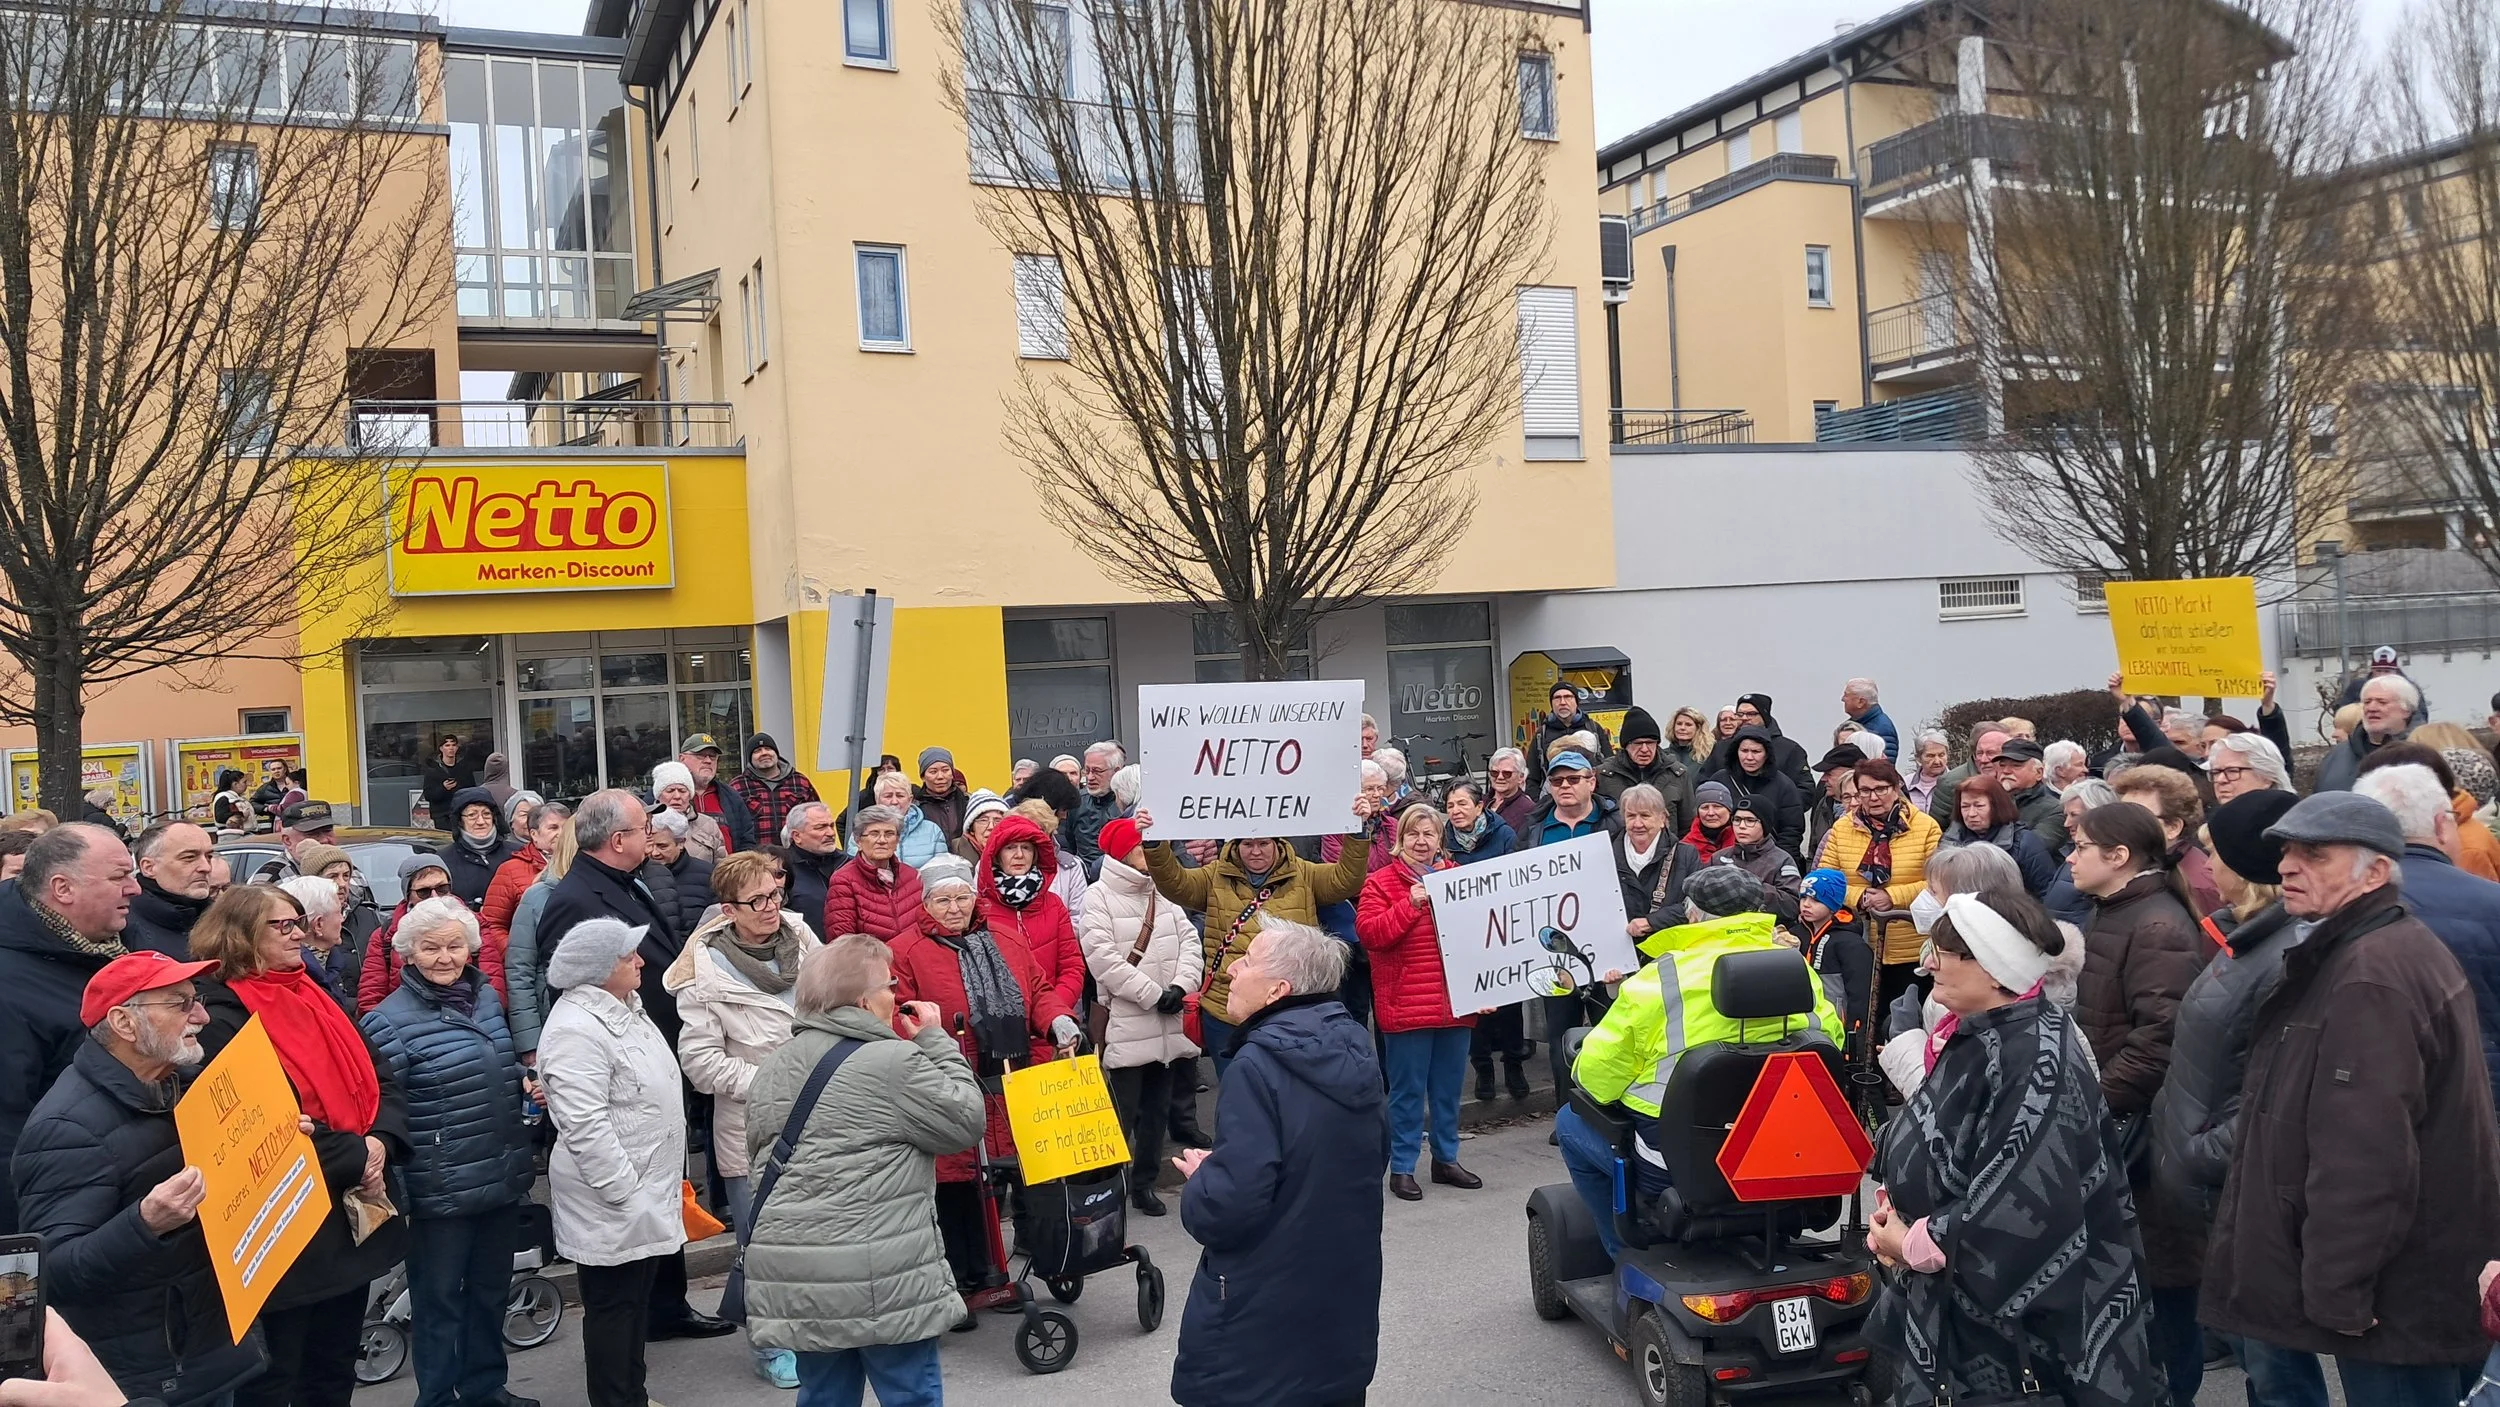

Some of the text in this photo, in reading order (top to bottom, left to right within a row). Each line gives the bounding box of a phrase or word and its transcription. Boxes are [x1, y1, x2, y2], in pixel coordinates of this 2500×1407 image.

[402, 476, 657, 555] Netto
[477, 561, 655, 582] Marken-Discount
[2128, 659, 2194, 678] LEBENSMITTEL
[1402, 682, 1482, 714] Netto
[2215, 678, 2263, 696] RAMSCH!
[1010, 704, 1099, 740] Netto
[1151, 701, 1345, 729] WIR WOLLEN UNSEREN
[1194, 738, 1302, 777] NETTO
[1178, 795, 1311, 820] BEHALTEN
[1444, 850, 1582, 904] NEHMT UNS DEN
[1485, 891, 1580, 949] NETTO
[1474, 958, 1535, 993] NICHT
[208, 1067, 240, 1120] NEIN
[1040, 1078, 1074, 1096] Unser
[1032, 1103, 1061, 1123] darf
[1066, 1096, 1090, 1117] nicht
[212, 1104, 266, 1167] zur Schließung
[1034, 1138, 1050, 1153] er
[1073, 1143, 1117, 1165] LEBEN
[222, 1184, 250, 1222] unseres
[1777, 1300, 1807, 1324] 834
[1780, 1324, 1811, 1348] GKW
